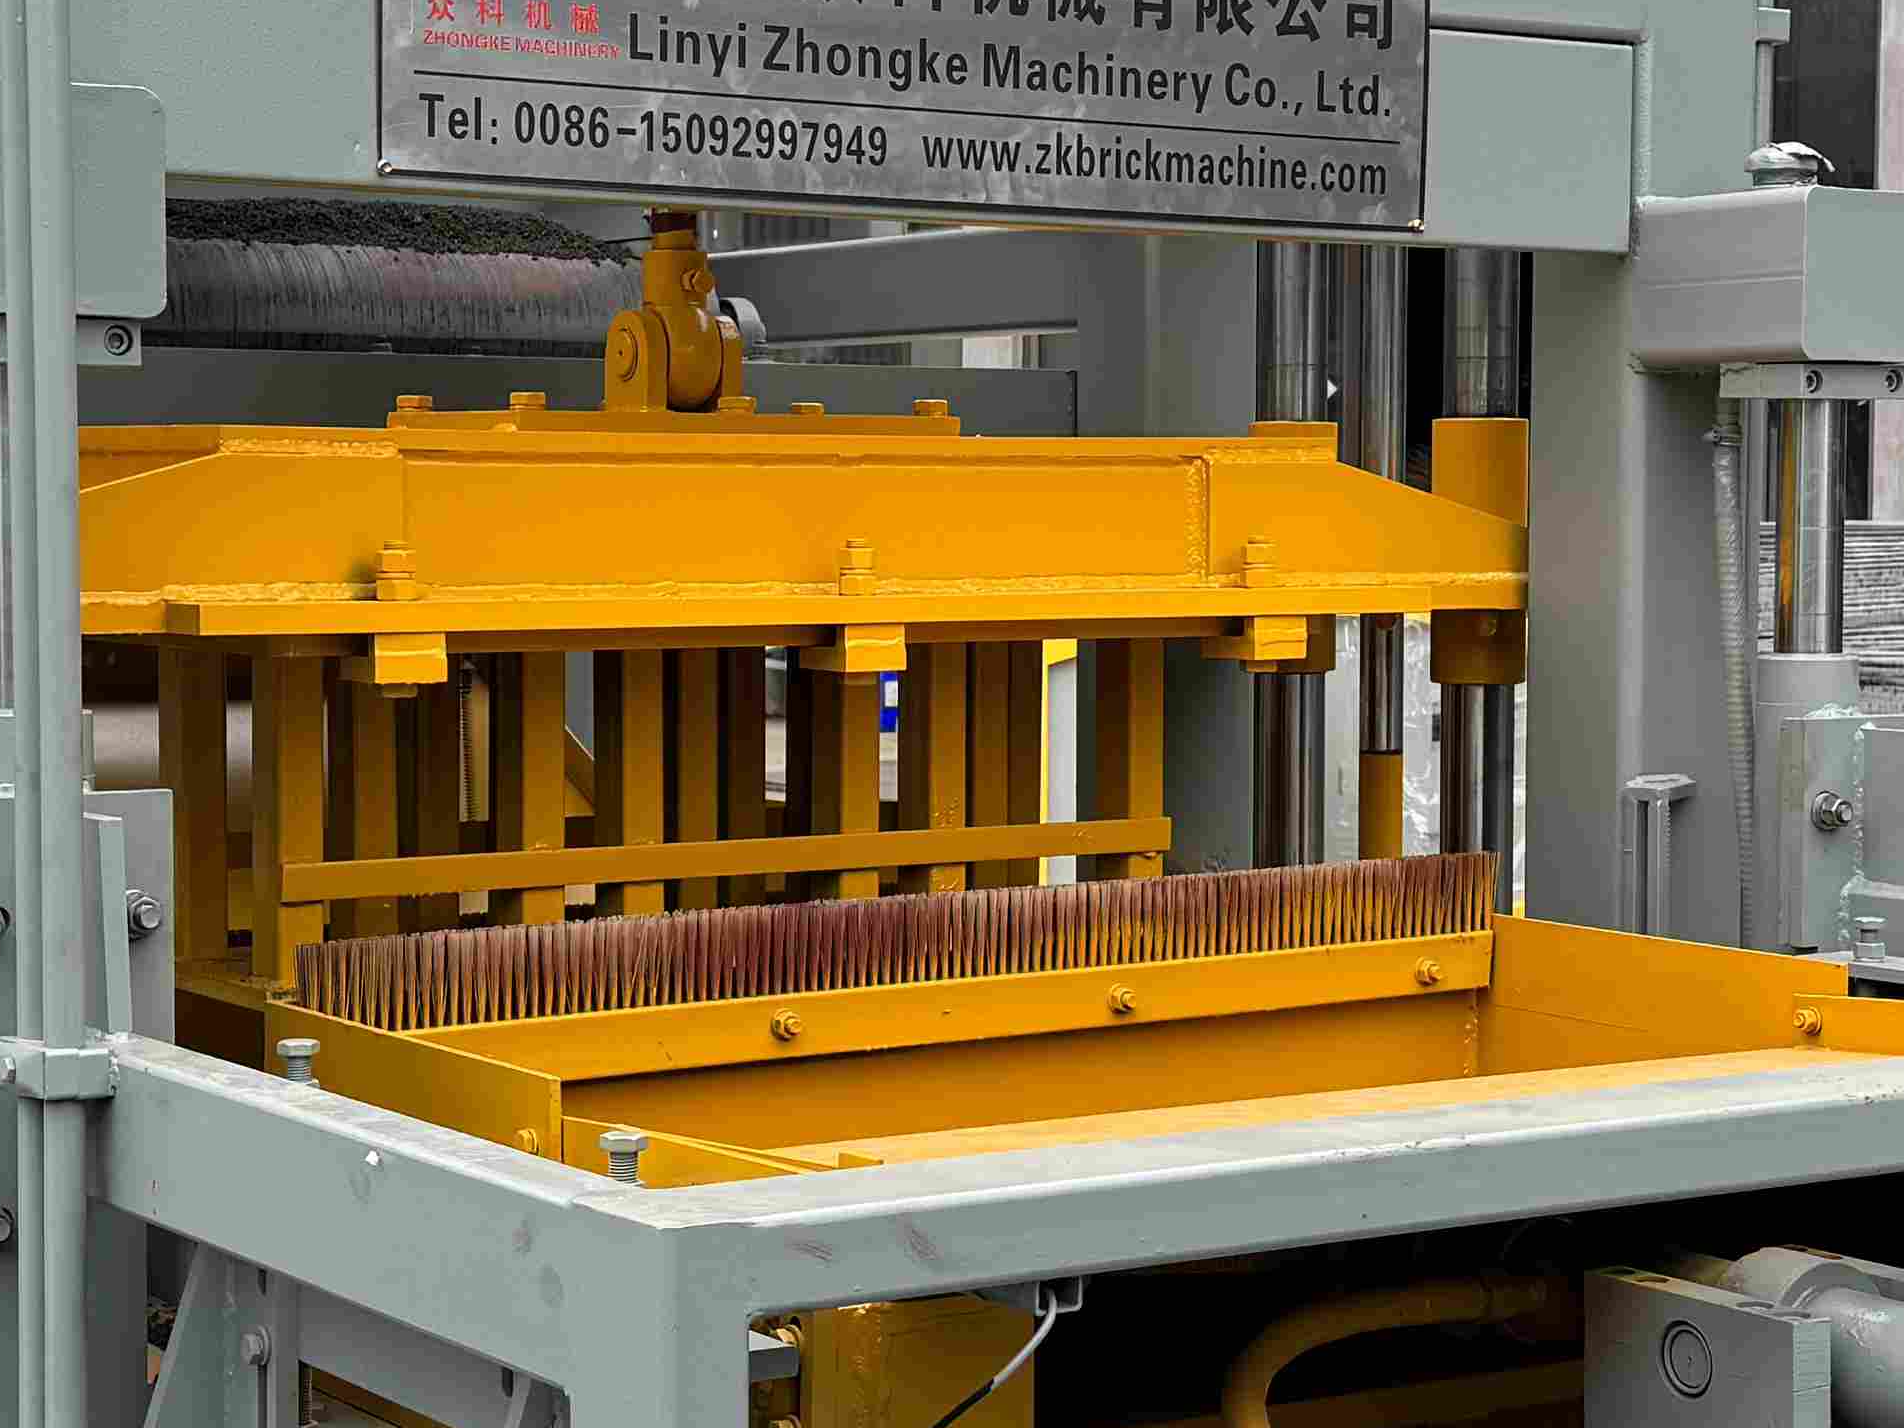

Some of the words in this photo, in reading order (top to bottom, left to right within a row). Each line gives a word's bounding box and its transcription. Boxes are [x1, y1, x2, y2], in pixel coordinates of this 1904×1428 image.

[423, 29, 513, 52] ZHONGKE
[514, 36, 621, 60] MACHINERY
[629, 12, 746, 78] Linyi
[762, 23, 969, 92] Zhongke
[982, 42, 1213, 114] Machinery
[1224, 62, 1303, 117] Co.,
[1316, 69, 1391, 118] Ltd.
[419, 92, 498, 146] Tel:
[514, 100, 888, 167] 0086-15092997949
[922, 131, 1387, 196] www.zkbrickmachine.com
